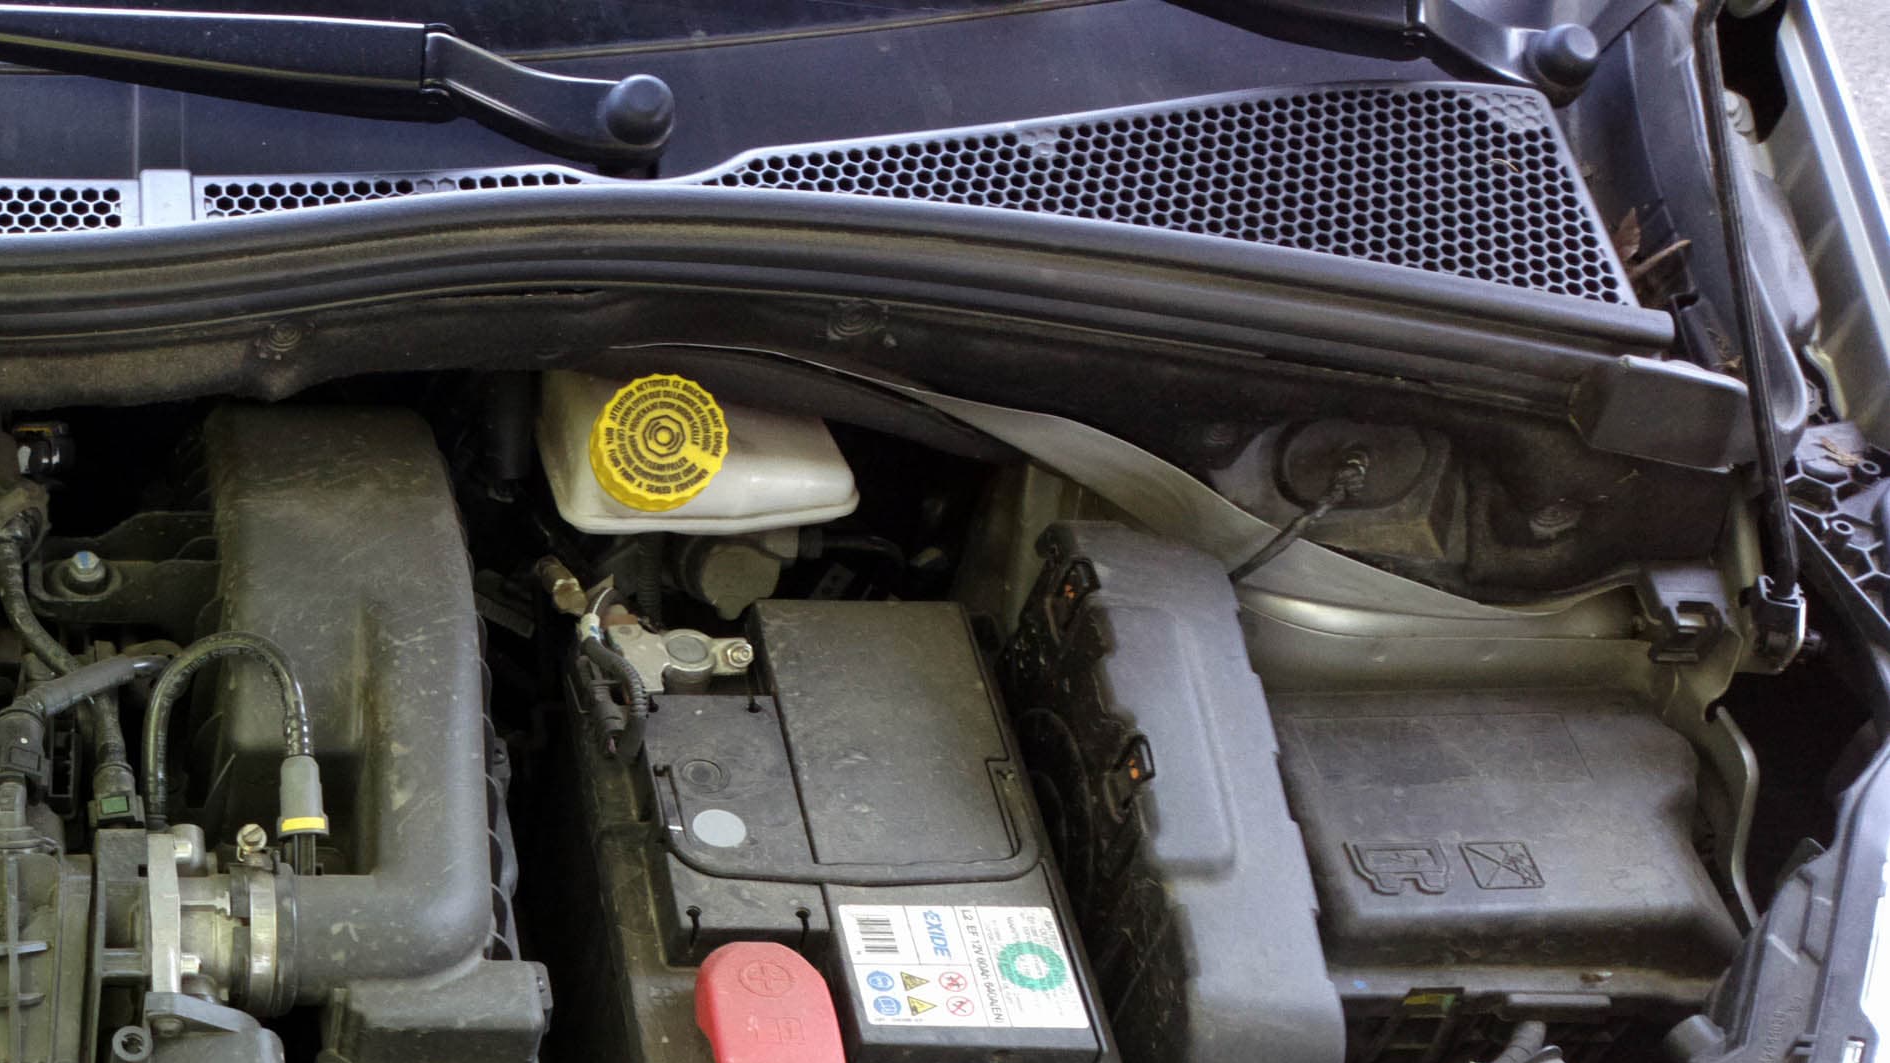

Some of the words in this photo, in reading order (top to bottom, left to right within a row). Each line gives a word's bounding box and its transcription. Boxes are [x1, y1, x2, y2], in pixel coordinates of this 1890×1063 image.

[961, 909, 973, 920] L2
[923, 911, 951, 957] EXIDE
[966, 925, 978, 936] EF
[972, 940, 984, 955] 12V
